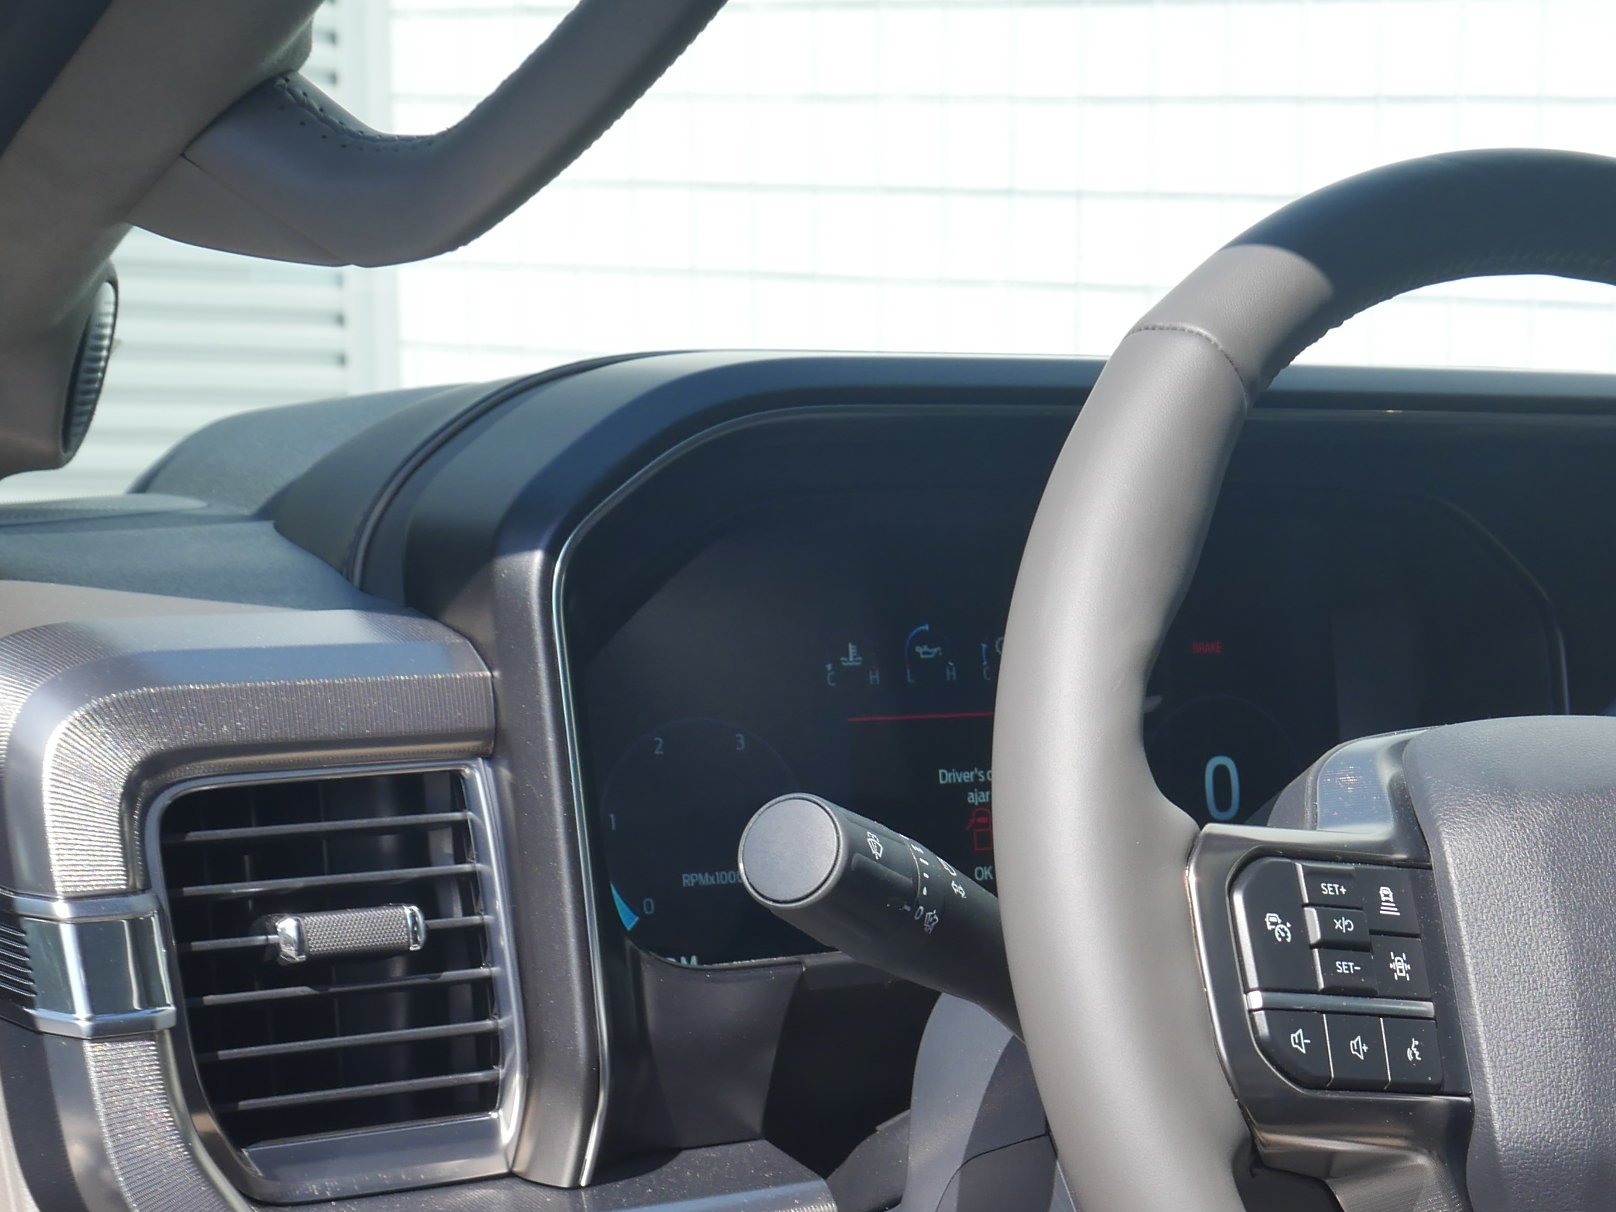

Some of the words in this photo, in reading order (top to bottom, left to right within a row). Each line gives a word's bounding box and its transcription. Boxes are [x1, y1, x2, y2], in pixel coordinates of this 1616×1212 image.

[653, 736, 664, 755] 2
[735, 733, 746, 751] 3
[938, 768, 985, 785] Driver's
[1204, 755, 1240, 821] 0
[967, 788, 991, 806] ajar
[974, 866, 994, 881] OK
[1320, 882, 1347, 895] SET+
[643, 898, 655, 915] 0
